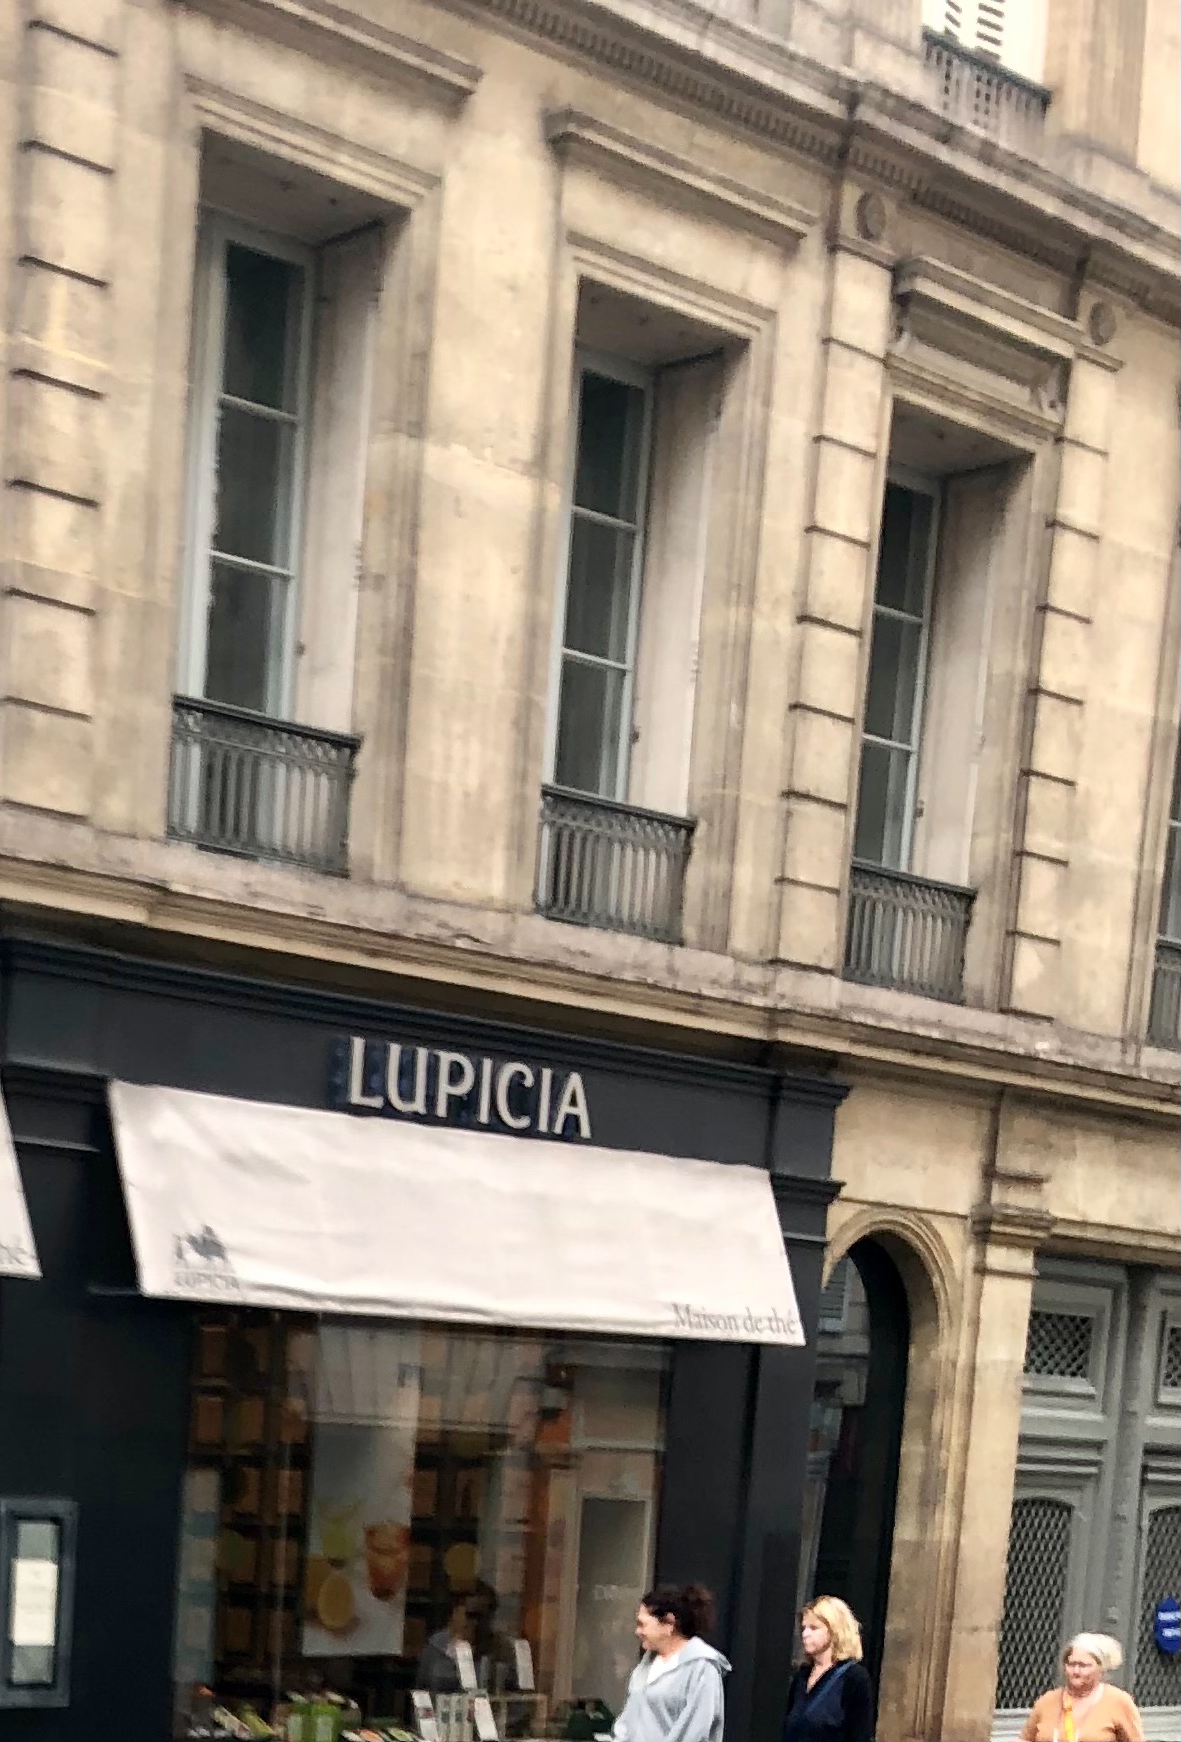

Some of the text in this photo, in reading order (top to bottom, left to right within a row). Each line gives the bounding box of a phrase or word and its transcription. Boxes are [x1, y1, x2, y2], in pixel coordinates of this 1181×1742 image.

[349, 1036, 592, 1139] LUPICIA
[671, 1303, 798, 1336] Maison de thé
